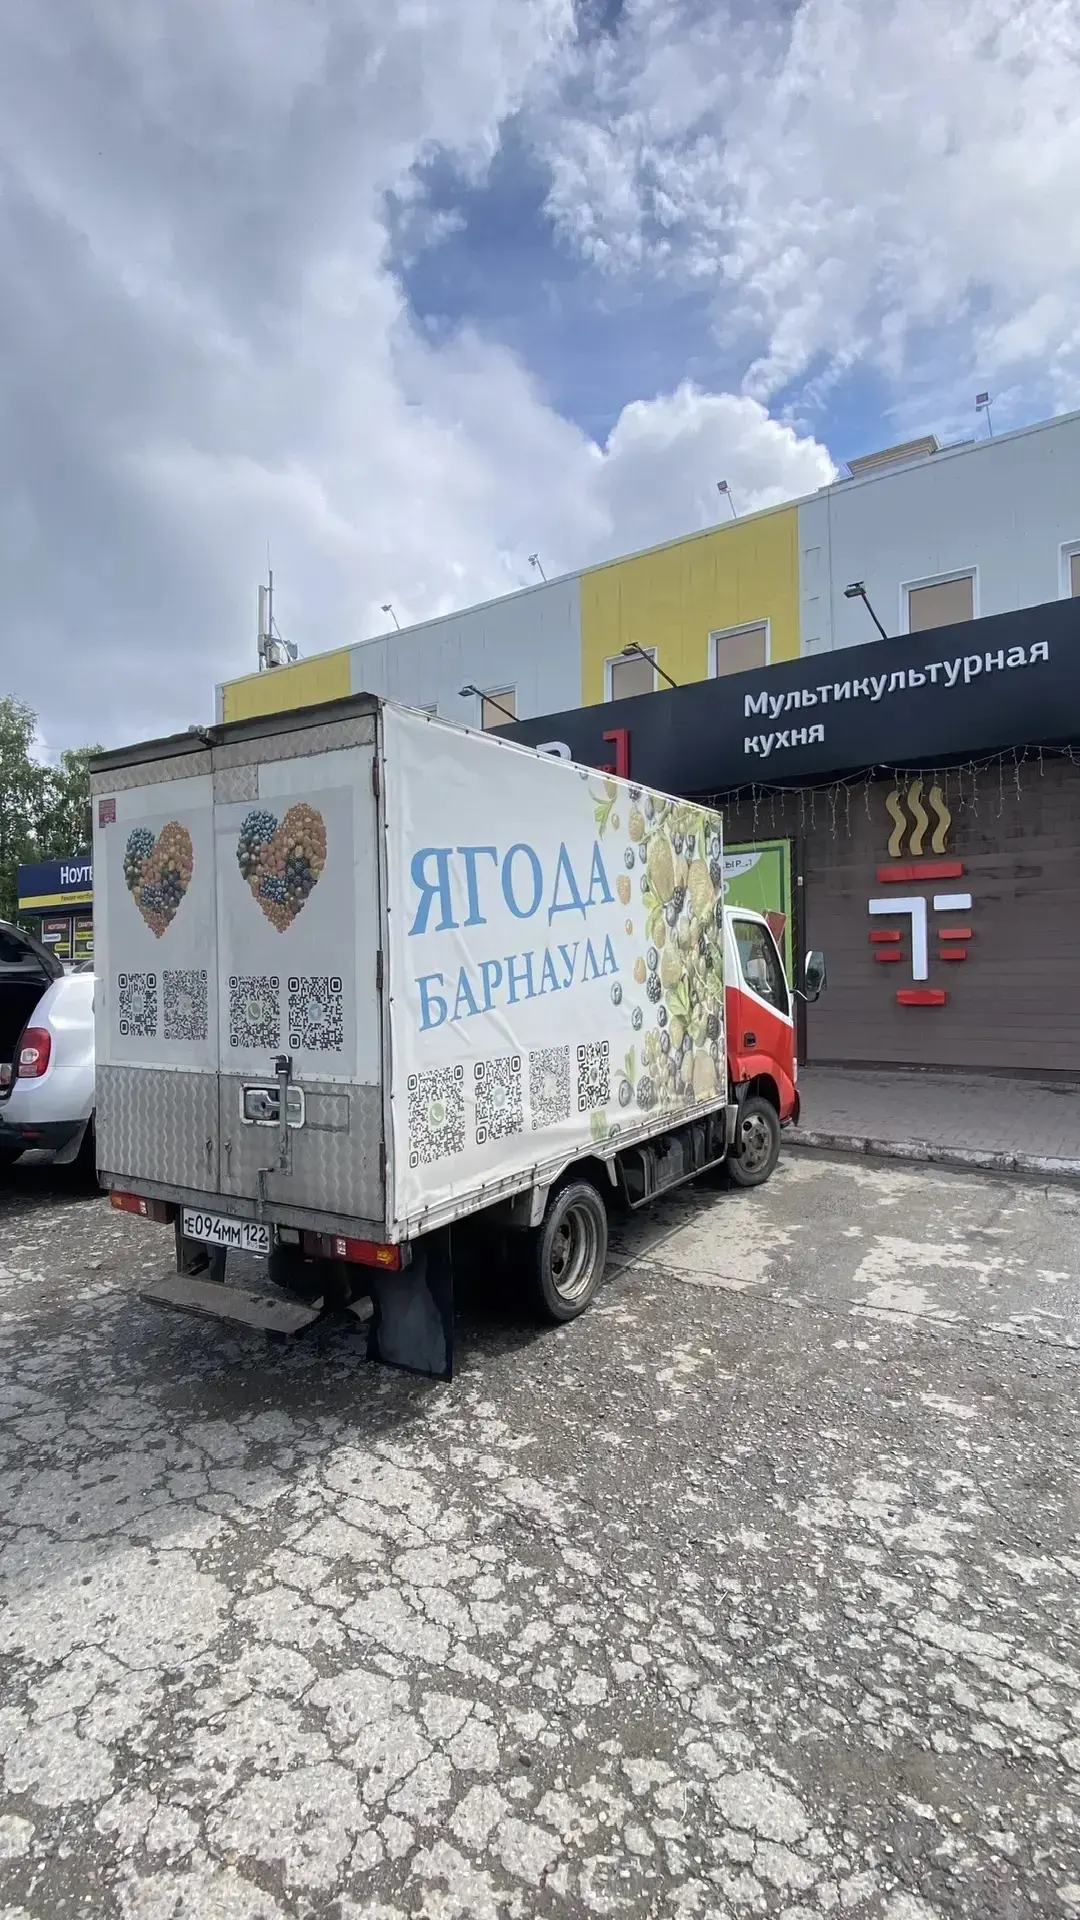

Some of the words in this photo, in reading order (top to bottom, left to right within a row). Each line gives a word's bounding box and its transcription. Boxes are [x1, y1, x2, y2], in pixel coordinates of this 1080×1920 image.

[744, 640, 1050, 719] Мультикультурная
[744, 723, 825, 758] кухня
[408, 840, 615, 936] ЯГОДА
[414, 932, 620, 1032] БАРНАУЛА
[243, 1223, 266, 1243] 122
